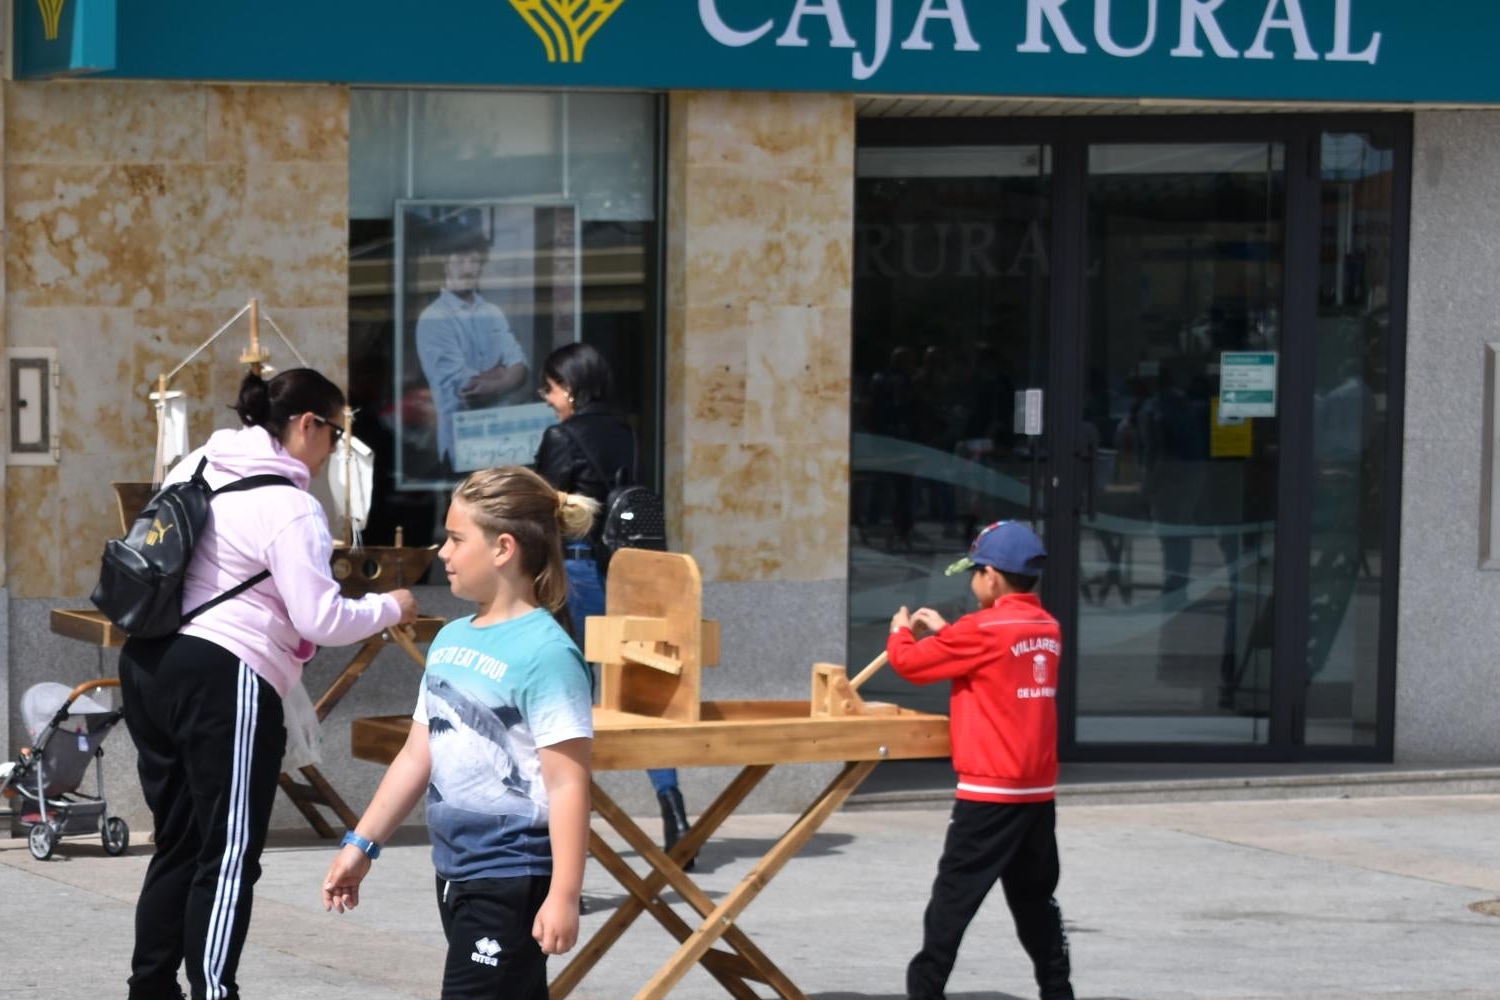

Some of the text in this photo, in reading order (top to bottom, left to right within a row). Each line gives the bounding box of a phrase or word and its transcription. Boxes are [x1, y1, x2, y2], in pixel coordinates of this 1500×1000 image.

[697, 0, 1381, 80] CAJA RURAL
[857, 219, 1102, 279] RURA
[473, 652, 509, 682] YOU!
